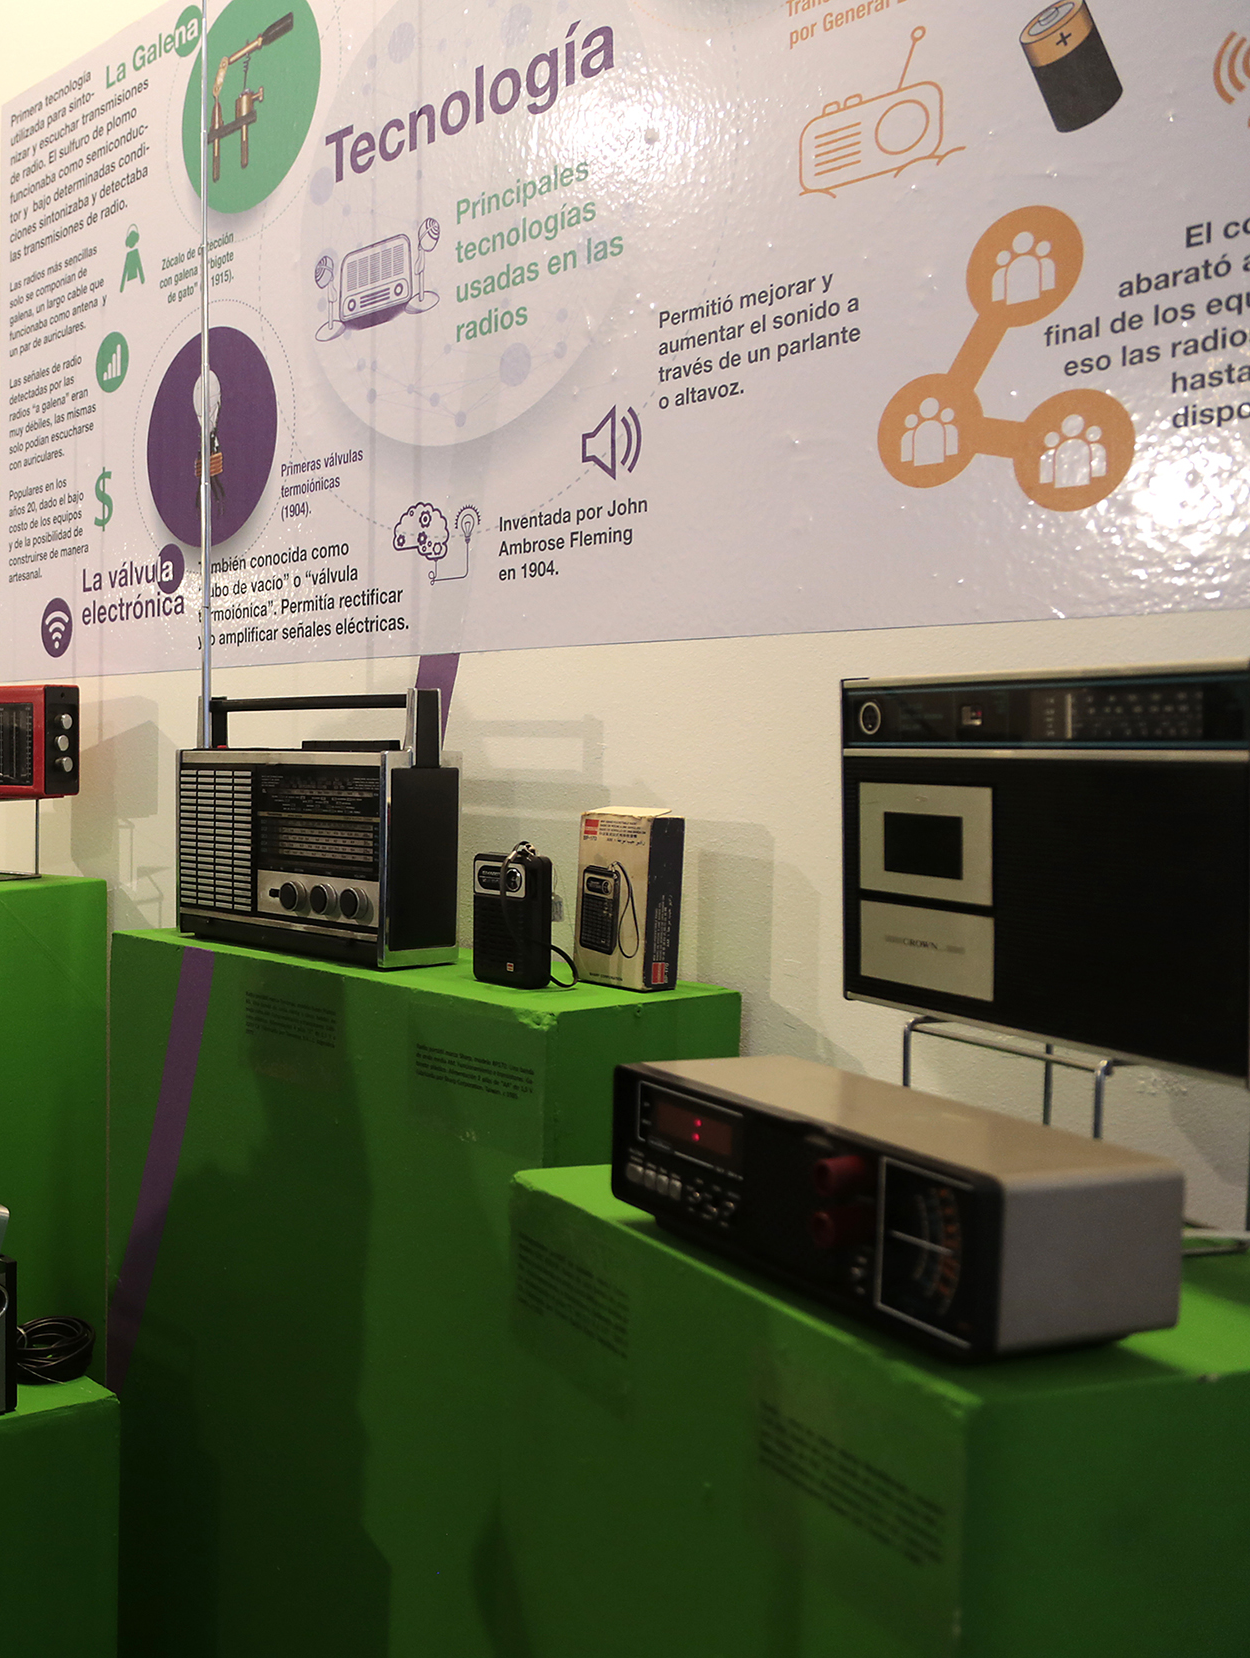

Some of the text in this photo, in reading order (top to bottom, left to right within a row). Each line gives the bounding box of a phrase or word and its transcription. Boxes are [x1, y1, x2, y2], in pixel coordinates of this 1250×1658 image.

[105, 17, 199, 89] La Galena
[790, 22, 818, 50] por
[10, 92, 95, 147] utilizada para sinto-
[10, 79, 149, 166] nizar escuchar transmisiones
[11, 70, 91, 127] Primera tecnología
[325, 19, 615, 184] Tecnología
[10, 107, 137, 185] de radio. El sulfuro de plomo
[10, 125, 149, 204] funcionaba como semiconduc-
[10, 142, 150, 224] tor bajo determinadas condi-
[10, 166, 149, 243] ciones sintonizaba y detectaba
[456, 161, 589, 225] Principales
[10, 198, 128, 263] las transmisiones de radio.
[455, 201, 597, 264] tecnologías
[1185, 221, 1212, 248] El
[456, 235, 624, 303] usadas en las
[1118, 253, 1232, 299] abarató
[456, 306, 528, 343] radios
[658, 272, 834, 329] Permitió mejorar y
[1044, 292, 1250, 347] final de los eq
[658, 297, 860, 355] aumentar el sonido a
[658, 327, 861, 382] través de un parlante
[1064, 327, 1250, 377] eso las radio
[658, 381, 745, 410] o altavoz.
[1172, 363, 1250, 393] hasta
[281, 449, 364, 477] Primeras válvulas
[281, 476, 341, 498] termoiónicas
[281, 501, 312, 522] (1904).
[499, 498, 648, 532] Inventada por John
[250, 542, 350, 569] conocida como
[498, 527, 633, 557] Ambrose Fleming
[82, 555, 174, 592] La válvula
[233, 575, 301, 595] de o
[498, 560, 559, 581] en 1904.
[82, 591, 185, 626] electrónica
[281, 588, 404, 615] Permitía rectificar
[219, 615, 409, 647] amplificar señales eléctricas.
